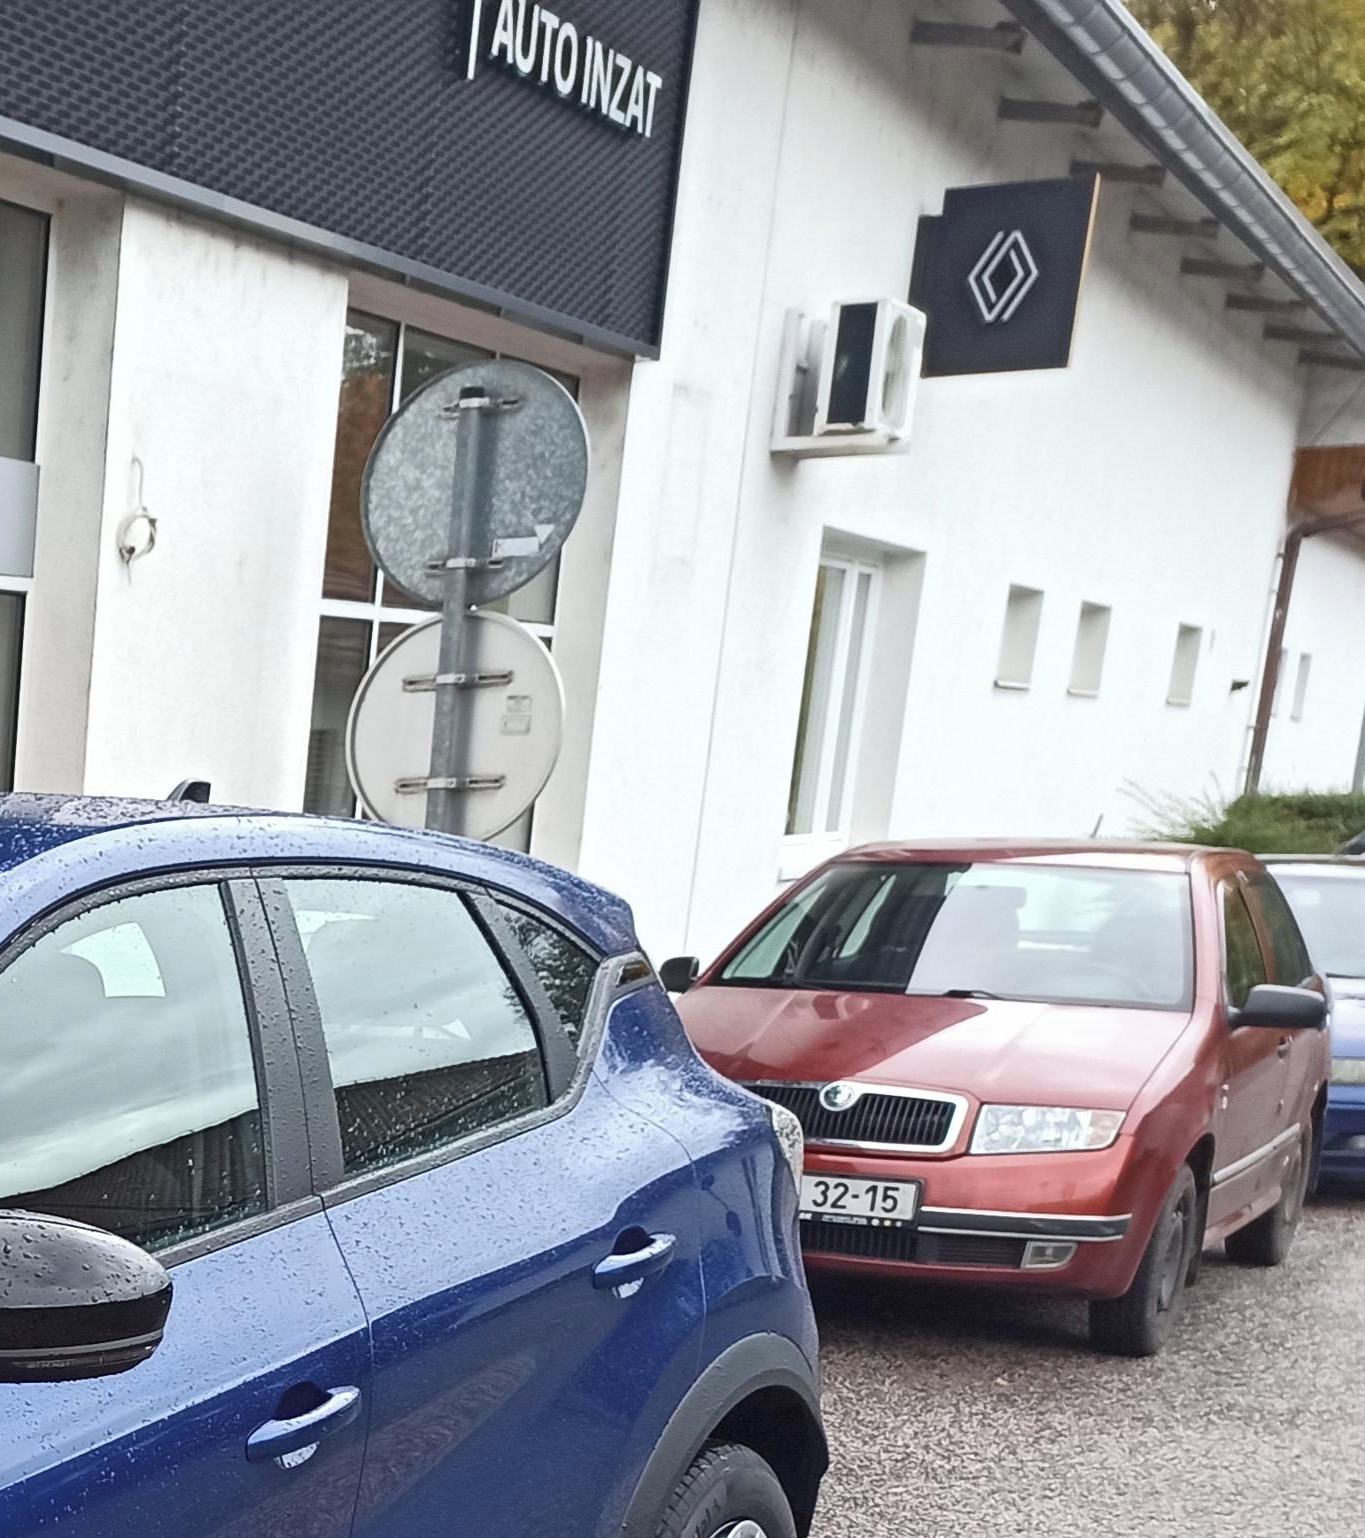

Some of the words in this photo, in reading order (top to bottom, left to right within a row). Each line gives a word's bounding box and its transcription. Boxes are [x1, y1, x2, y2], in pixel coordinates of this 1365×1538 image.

[490, 0, 578, 95] AUTO
[581, 36, 663, 138] INZAT
[812, 1180, 901, 1214] 32-15
